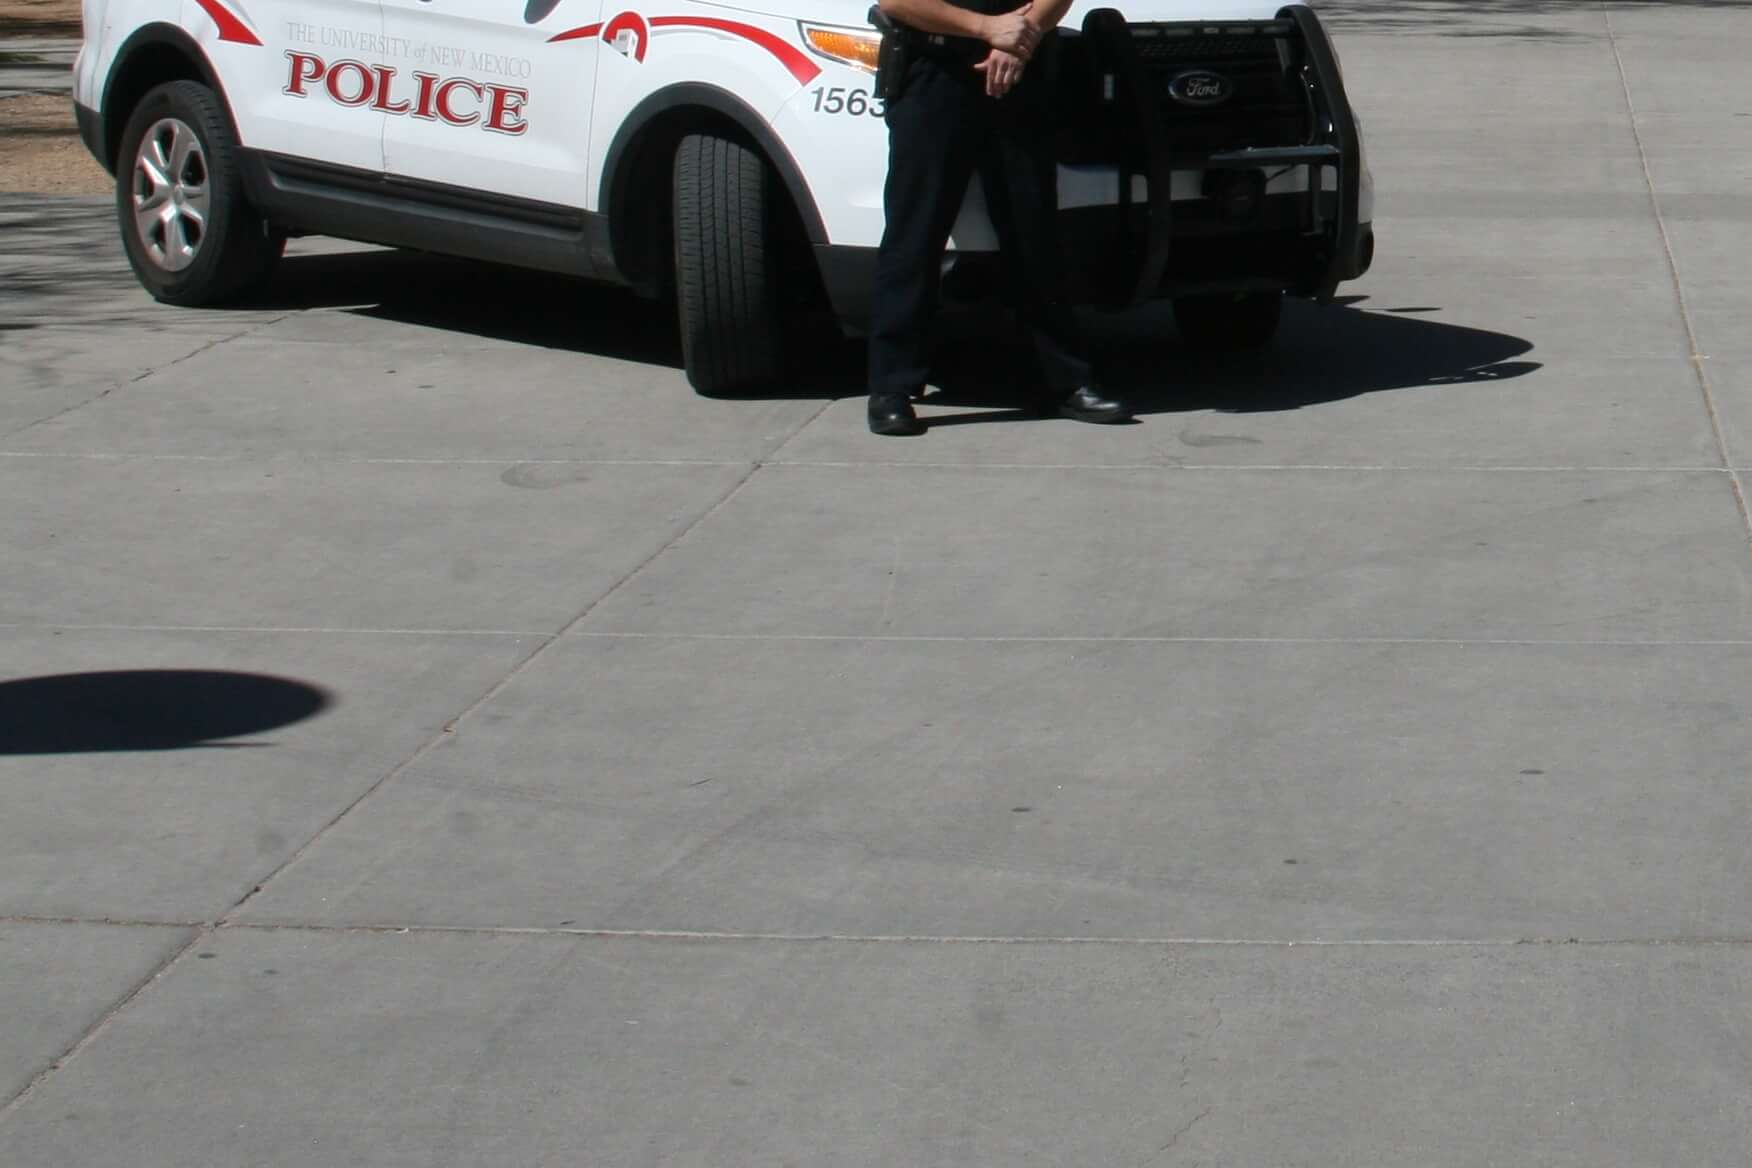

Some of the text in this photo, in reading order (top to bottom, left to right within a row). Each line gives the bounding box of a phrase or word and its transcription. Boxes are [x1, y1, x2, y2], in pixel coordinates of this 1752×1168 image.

[287, 22, 317, 44] THE
[320, 27, 410, 58] UNIVERSITY
[430, 47, 466, 68] NEW
[471, 51, 532, 79] MEXICO
[282, 49, 529, 136] POLICE
[811, 86, 887, 118] 1563
[1186, 78, 1220, 97] Ford
